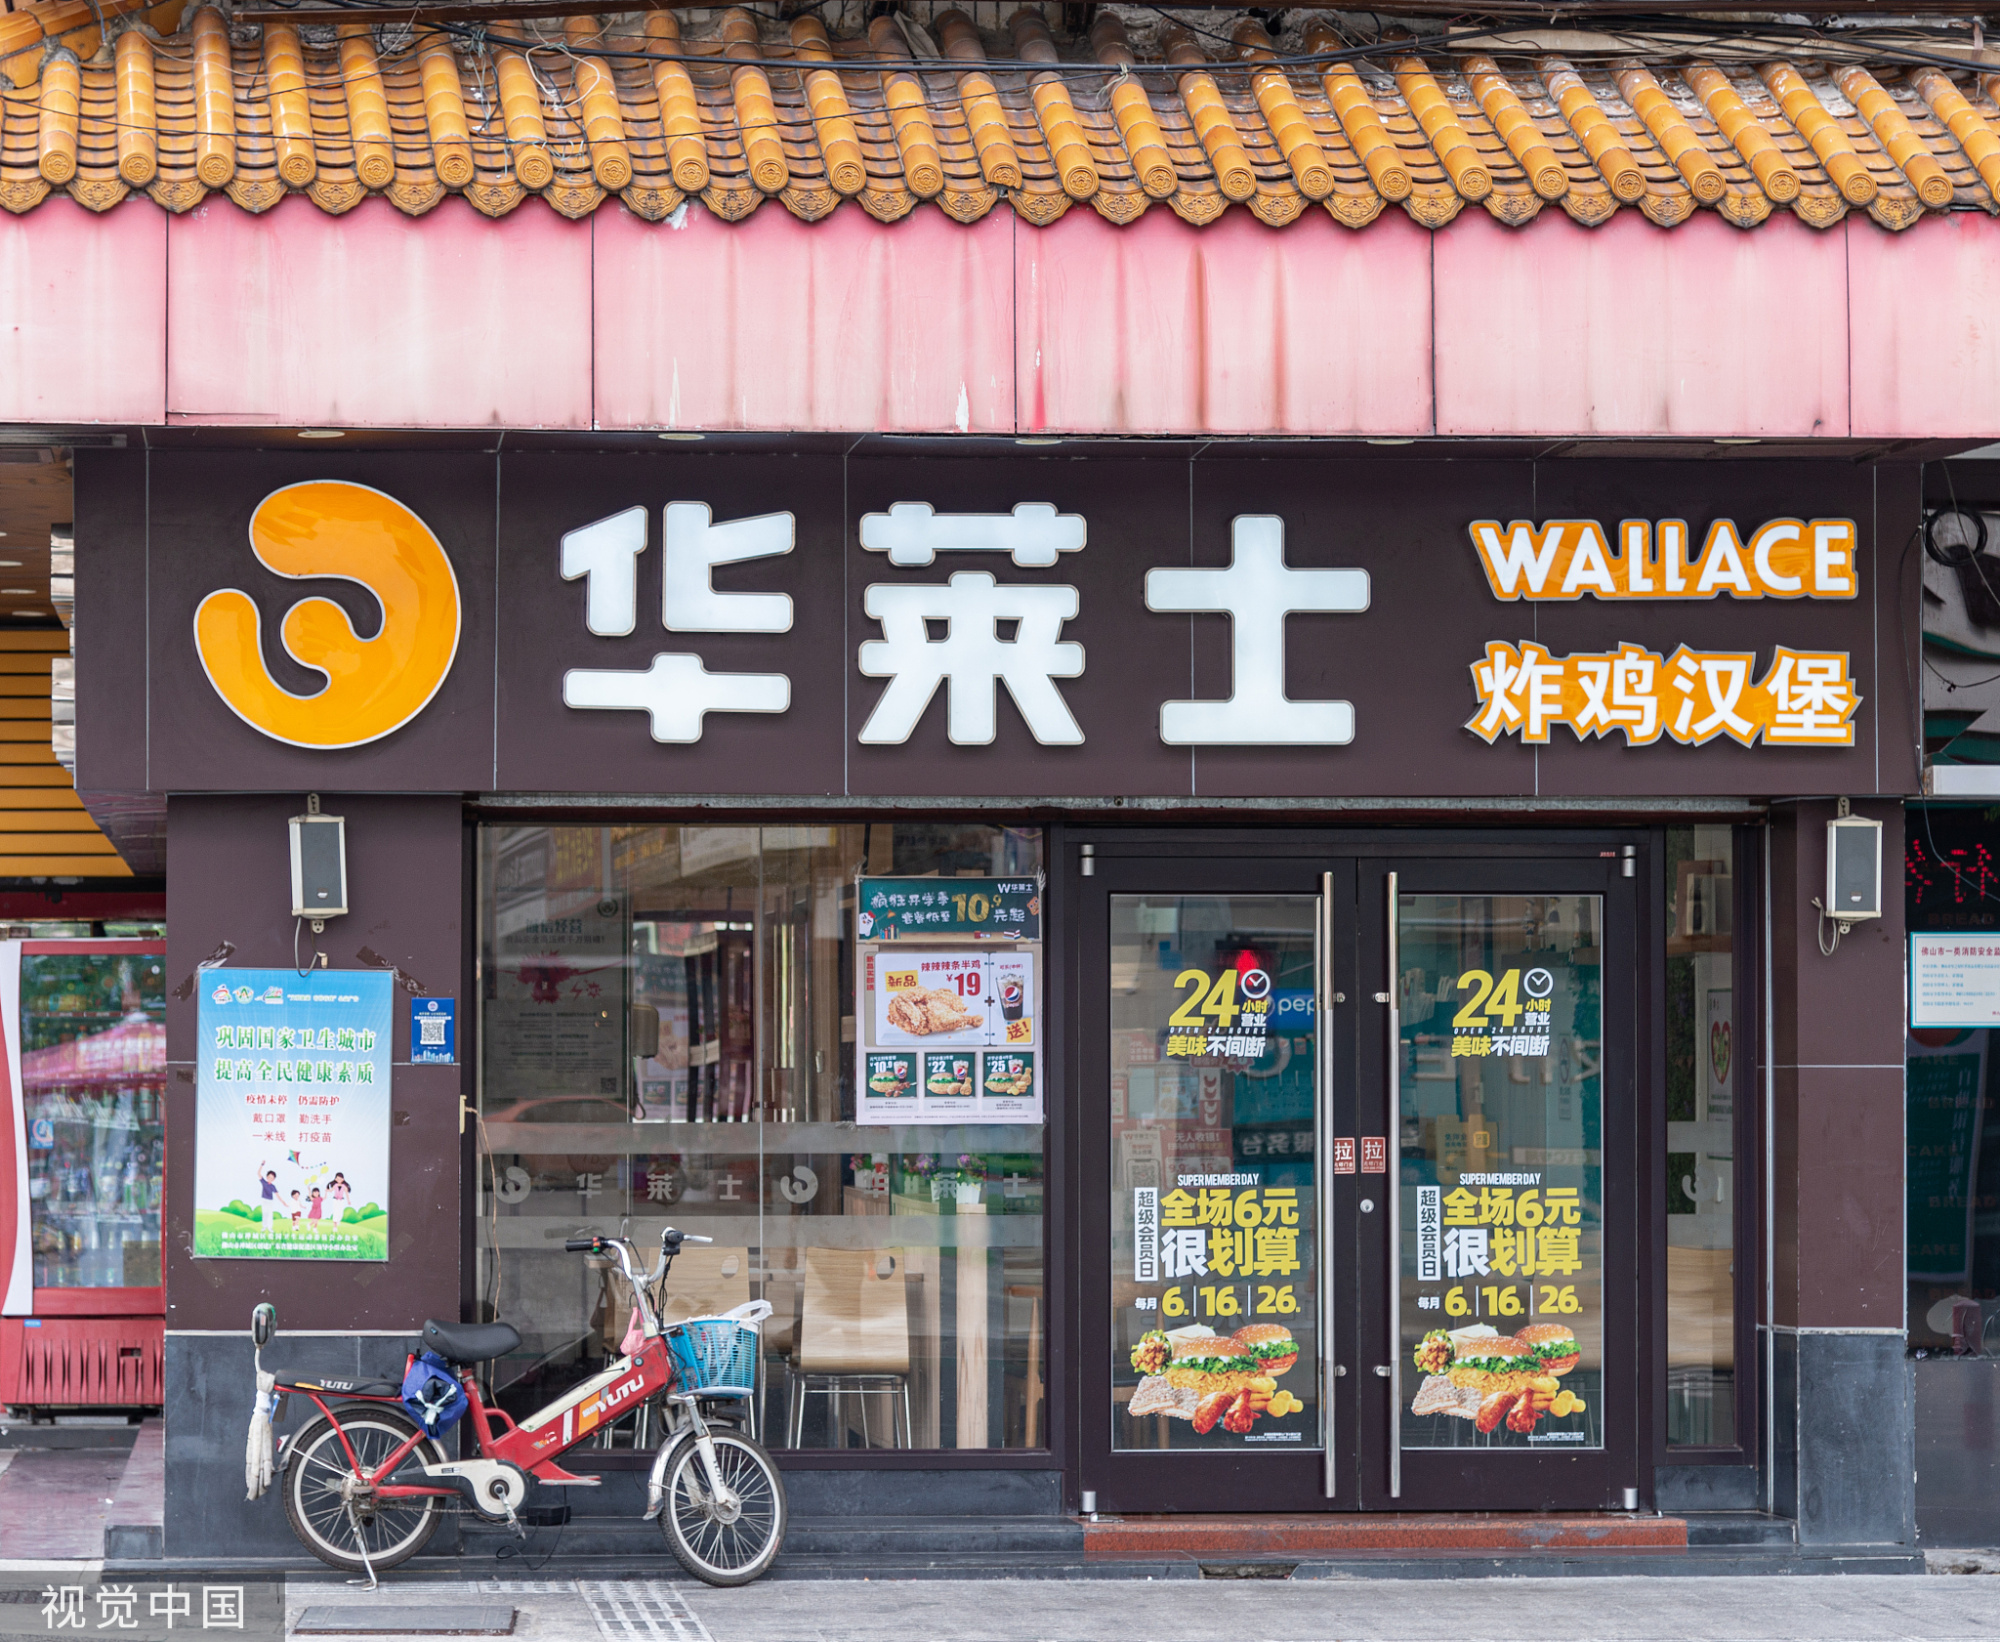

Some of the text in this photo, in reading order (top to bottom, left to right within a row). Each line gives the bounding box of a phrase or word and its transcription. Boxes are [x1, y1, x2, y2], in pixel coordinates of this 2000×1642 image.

[1477, 524, 1850, 594] WALLACE
[560, 500, 1371, 745] 华莱士
[1478, 649, 1851, 739] 炸鸡汉堡
[1011, 883, 1033, 891] 华莱士
[871, 891, 949, 908] 疯狂开学季
[901, 910, 950, 925] 套餐低至
[993, 907, 1025, 923] 元起
[921, 960, 981, 972] 辣辣辣条半鸡
[888, 975, 916, 987] 新品
[1168, 969, 1240, 1027] 24
[1452, 968, 1523, 1027] 24
[1525, 998, 1551, 1012] 小时
[1242, 1000, 1268, 1013] 小时
[1241, 1013, 1266, 1027] 营业
[1525, 1012, 1550, 1026] 营业
[216, 1025, 375, 1051] 巩固国家卫生城市
[1170, 1026, 1266, 1034] OPEN 24 HOURS
[1454, 1026, 1550, 1034] OPEN 24 HOURS
[1166, 1035, 1266, 1057] 美味不间断
[1451, 1035, 1550, 1057] 美味不间断
[215, 1059, 374, 1084] 提高全民健康素质
[246, 1095, 340, 1106] 疫情未停 仍需防护
[253, 1113, 332, 1125] 戴口罩 勤洗手
[252, 1131, 332, 1143] 一米线 打疫苗
[1335, 1142, 1352, 1161] 拉
[1365, 1141, 1382, 1160] 拉
[577, 1173, 742, 1200] 华莱士
[1178, 1174, 1259, 1186] SUPER MEMBER DAY
[1460, 1173, 1541, 1185] SUPER MEMBER DAY
[1160, 1188, 1299, 1228] 全场6元
[1442, 1187, 1581, 1227] 全场6元
[1138, 1191, 1155, 1277] 超级会员日
[1420, 1190, 1437, 1277] 超级会员日
[1160, 1228, 1300, 1277] 很划算
[1443, 1227, 1582, 1277] 很划算
[1135, 1297, 1157, 1310] 每月
[1417, 1296, 1440, 1310] 每月
[320, 1379, 353, 1390] YUTU
[597, 1374, 644, 1412] YUTU
